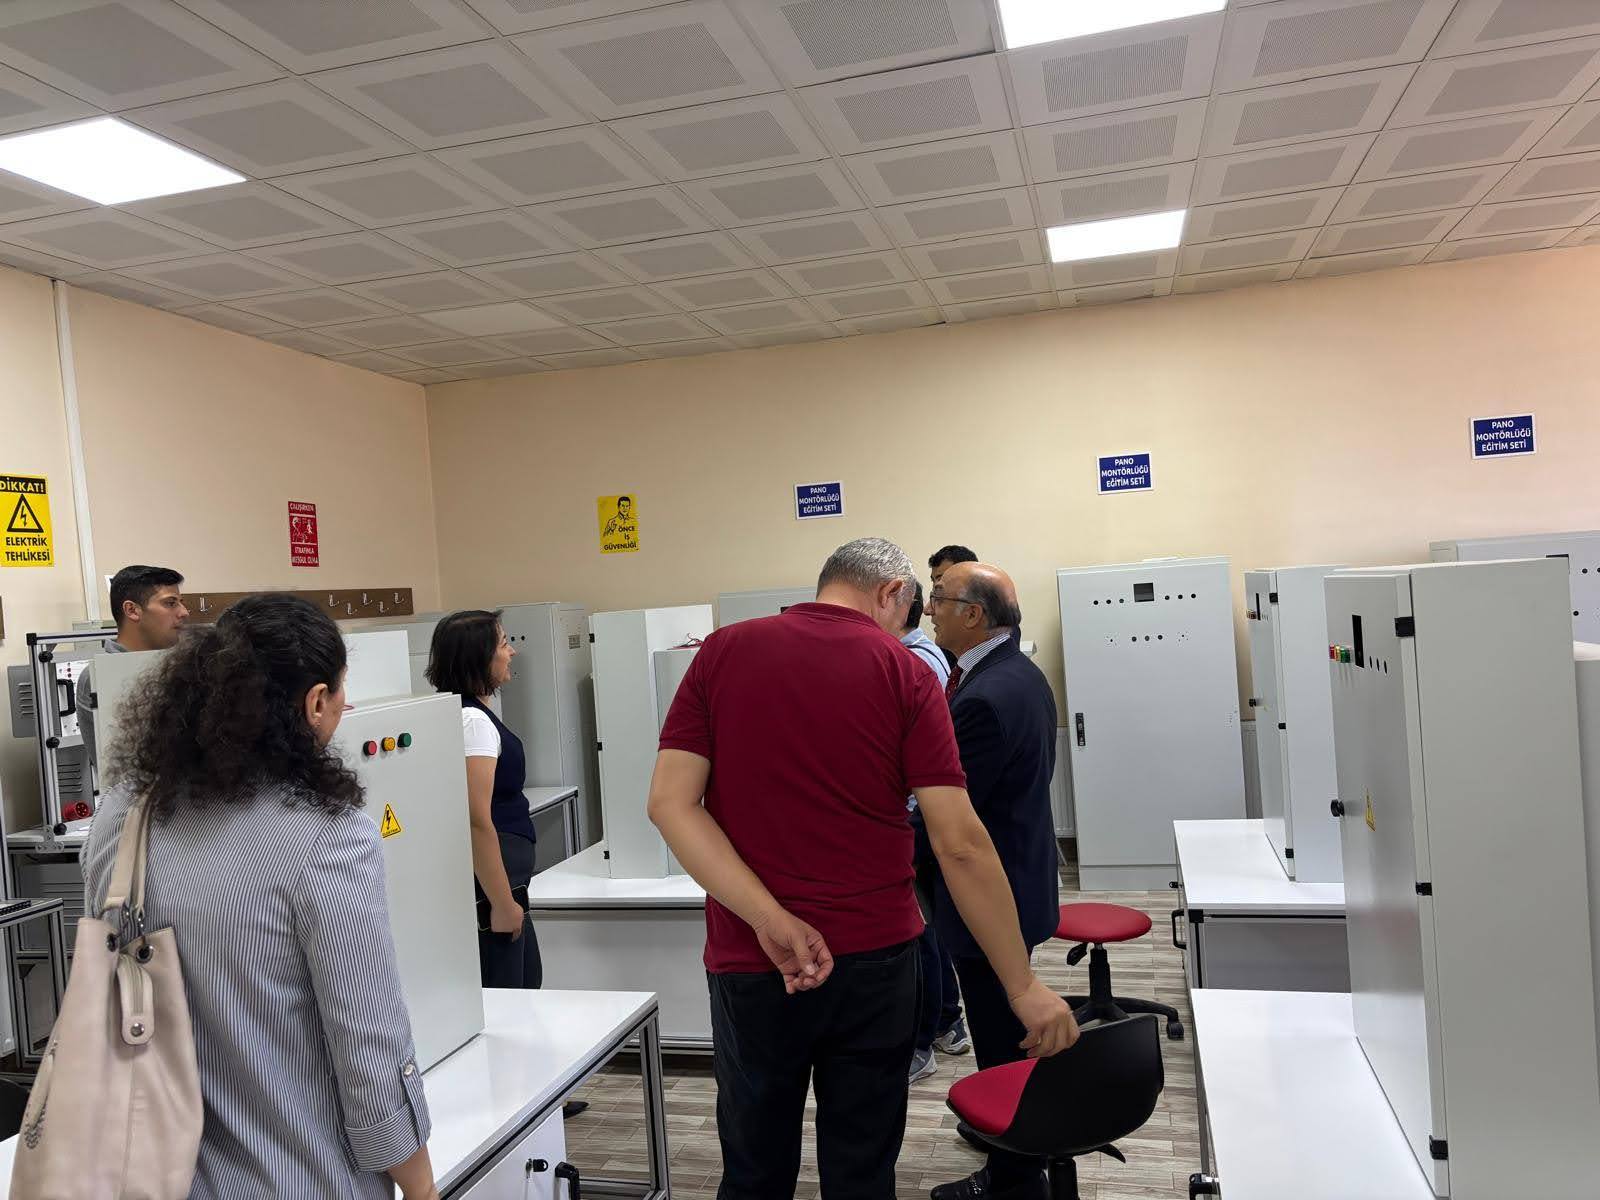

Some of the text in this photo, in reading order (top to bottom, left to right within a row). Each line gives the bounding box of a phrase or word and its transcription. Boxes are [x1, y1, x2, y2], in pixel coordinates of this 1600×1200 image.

[1491, 420, 1514, 429] PANO
[1476, 428, 1531, 441] MONTÖRLÜĞÜ
[1481, 439, 1526, 452] EĞİTİM SETİ
[1114, 458, 1134, 466] PANO
[1101, 465, 1149, 478] MONTÖRLÜĞÜ
[0, 478, 44, 493] DİKKAT!
[1106, 475, 1145, 488] EĞİTİM SETİ
[799, 493, 840, 505] MONTÖRLÜĞÜ
[803, 503, 837, 514] EĞİTİM SETİ
[5, 534, 48, 547] ELEKTRİK
[5, 548, 50, 561] TEHLİKESİ
